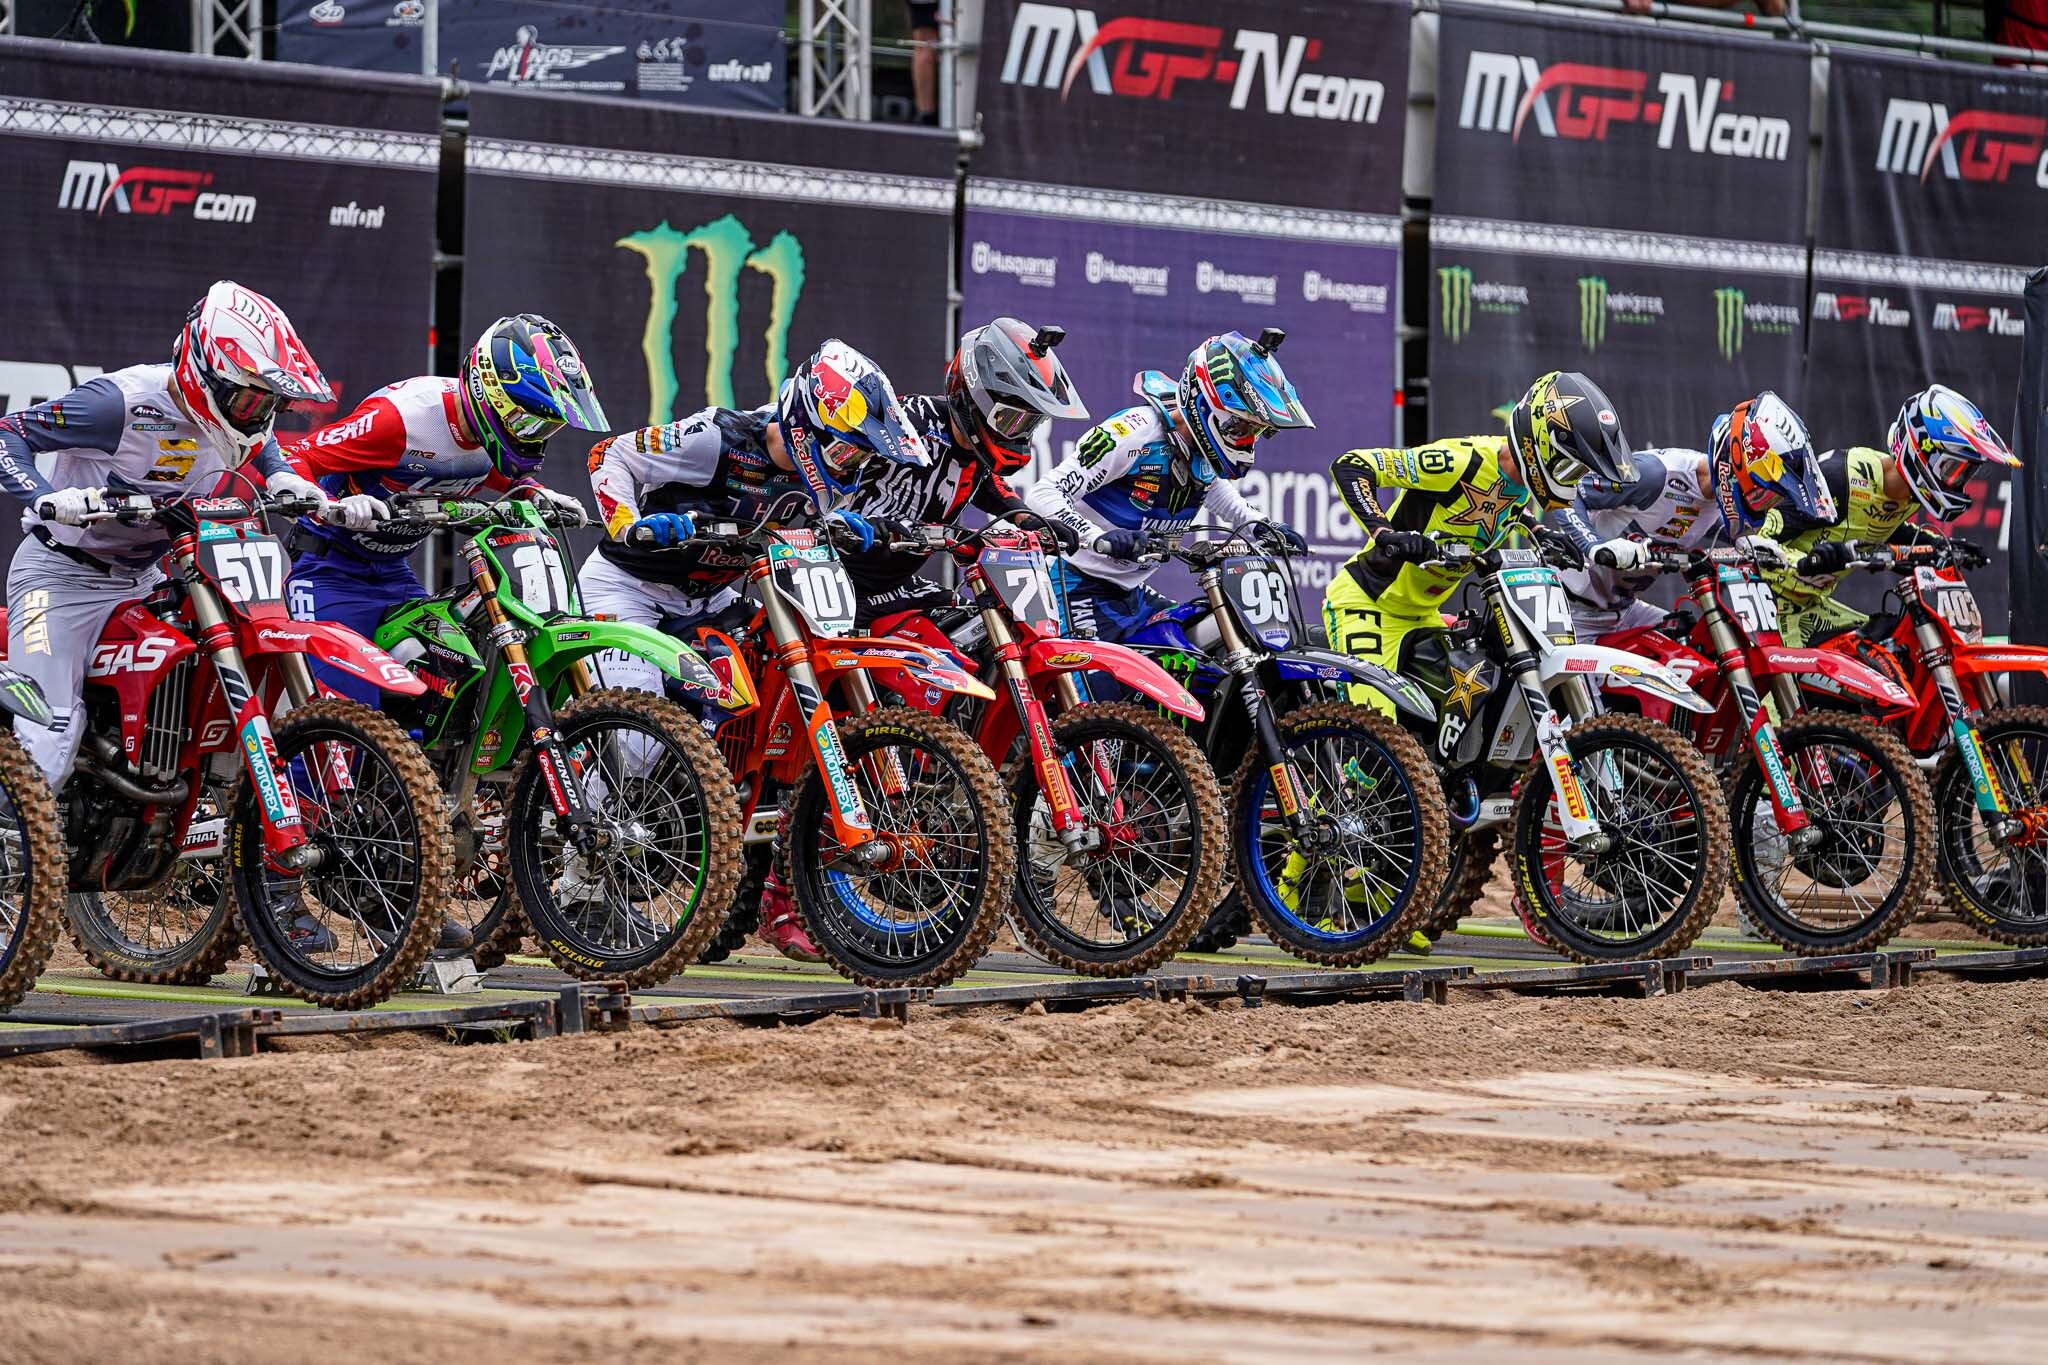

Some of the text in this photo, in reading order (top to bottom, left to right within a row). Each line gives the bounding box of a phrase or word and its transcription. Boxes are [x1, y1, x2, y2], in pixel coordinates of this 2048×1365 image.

[470, 370, 484, 400] Arai
[559, 358, 578, 371] Arai
[408, 449, 436, 460] MX2
[790, 427, 827, 492] Red Bull
[1128, 448, 1151, 458] MX2
[1523, 436, 1546, 497] ROCKSTAR
[1086, 469, 1108, 493] MAHA
[728, 496, 797, 520] THO
[1055, 508, 1091, 534] YAMAHA
[1564, 508, 1598, 543] ASGAS
[212, 541, 282, 602] 517
[792, 567, 853, 620] 101
[1240, 571, 1290, 624] 93
[1516, 586, 1573, 631] 74
[1728, 582, 1778, 632] 516
[1938, 591, 1981, 626] 403
[259, 629, 310, 641] Polisport
[1344, 608, 1382, 656] FO
[1494, 607, 1513, 645] JUMBO
[1049, 653, 1091, 667] FMF
[1768, 655, 1818, 664] Polisport
[865, 726, 924, 743] PIRELLI
[1294, 719, 1350, 733] PIRELLI
[1764, 752, 1791, 802] MOTOREX
[1959, 733, 1985, 782] MOTOREX
[250, 752, 280, 816] MOTOREX
[552, 748, 581, 810] DUNLOP
[822, 749, 850, 812] MOTOREX
[1046, 762, 1068, 807] PIRELLI
[1273, 767, 1294, 812] PIRELLI
[1554, 758, 1580, 818] PIRELLI
[183, 831, 218, 845] THAL
[1518, 854, 1546, 918] PIRELLI
[550, 938, 605, 968] DUNLOP
